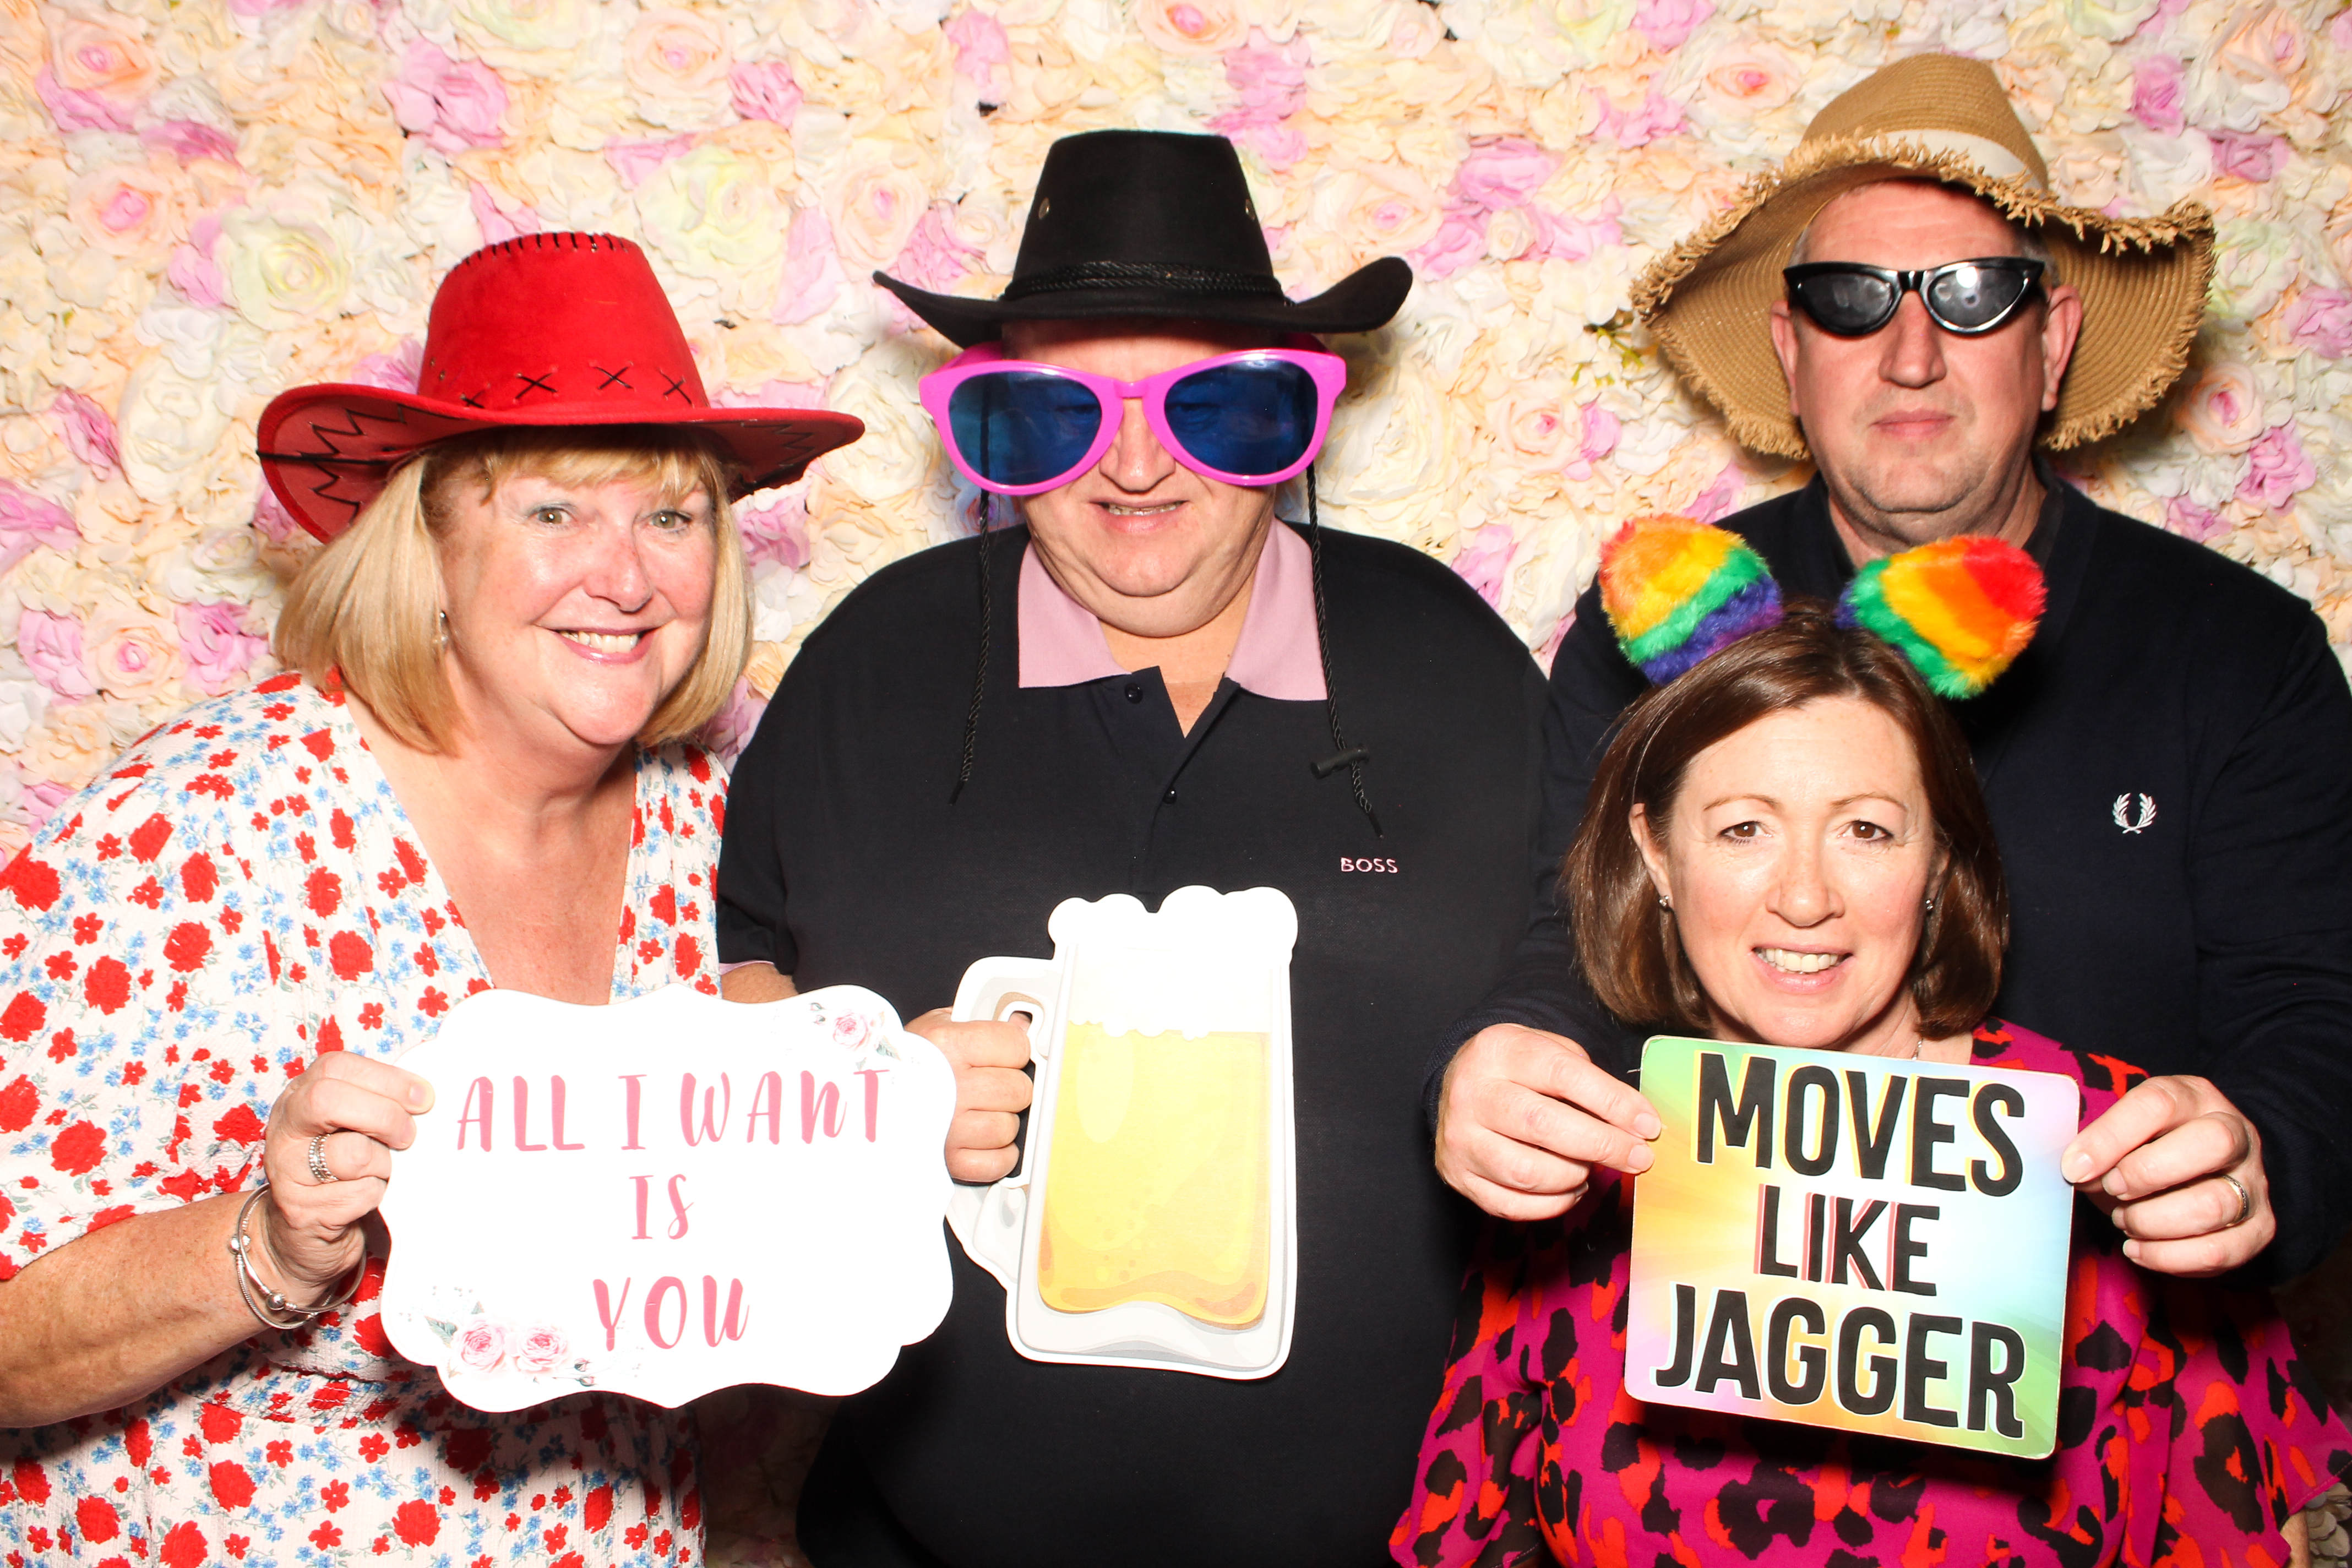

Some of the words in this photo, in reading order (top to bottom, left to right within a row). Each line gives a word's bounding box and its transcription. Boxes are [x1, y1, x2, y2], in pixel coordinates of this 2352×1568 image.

[1340, 857, 1398, 873] BOSS
[457, 1075, 585, 1152] ALL
[618, 1074, 647, 1150] I
[1692, 1050, 2025, 1197] MOVES
[629, 1173, 694, 1240] IS
[1755, 1183, 1940, 1297] LIKE
[593, 1275, 750, 1351] YOU
[1652, 1282, 2026, 1439] JAGGER
